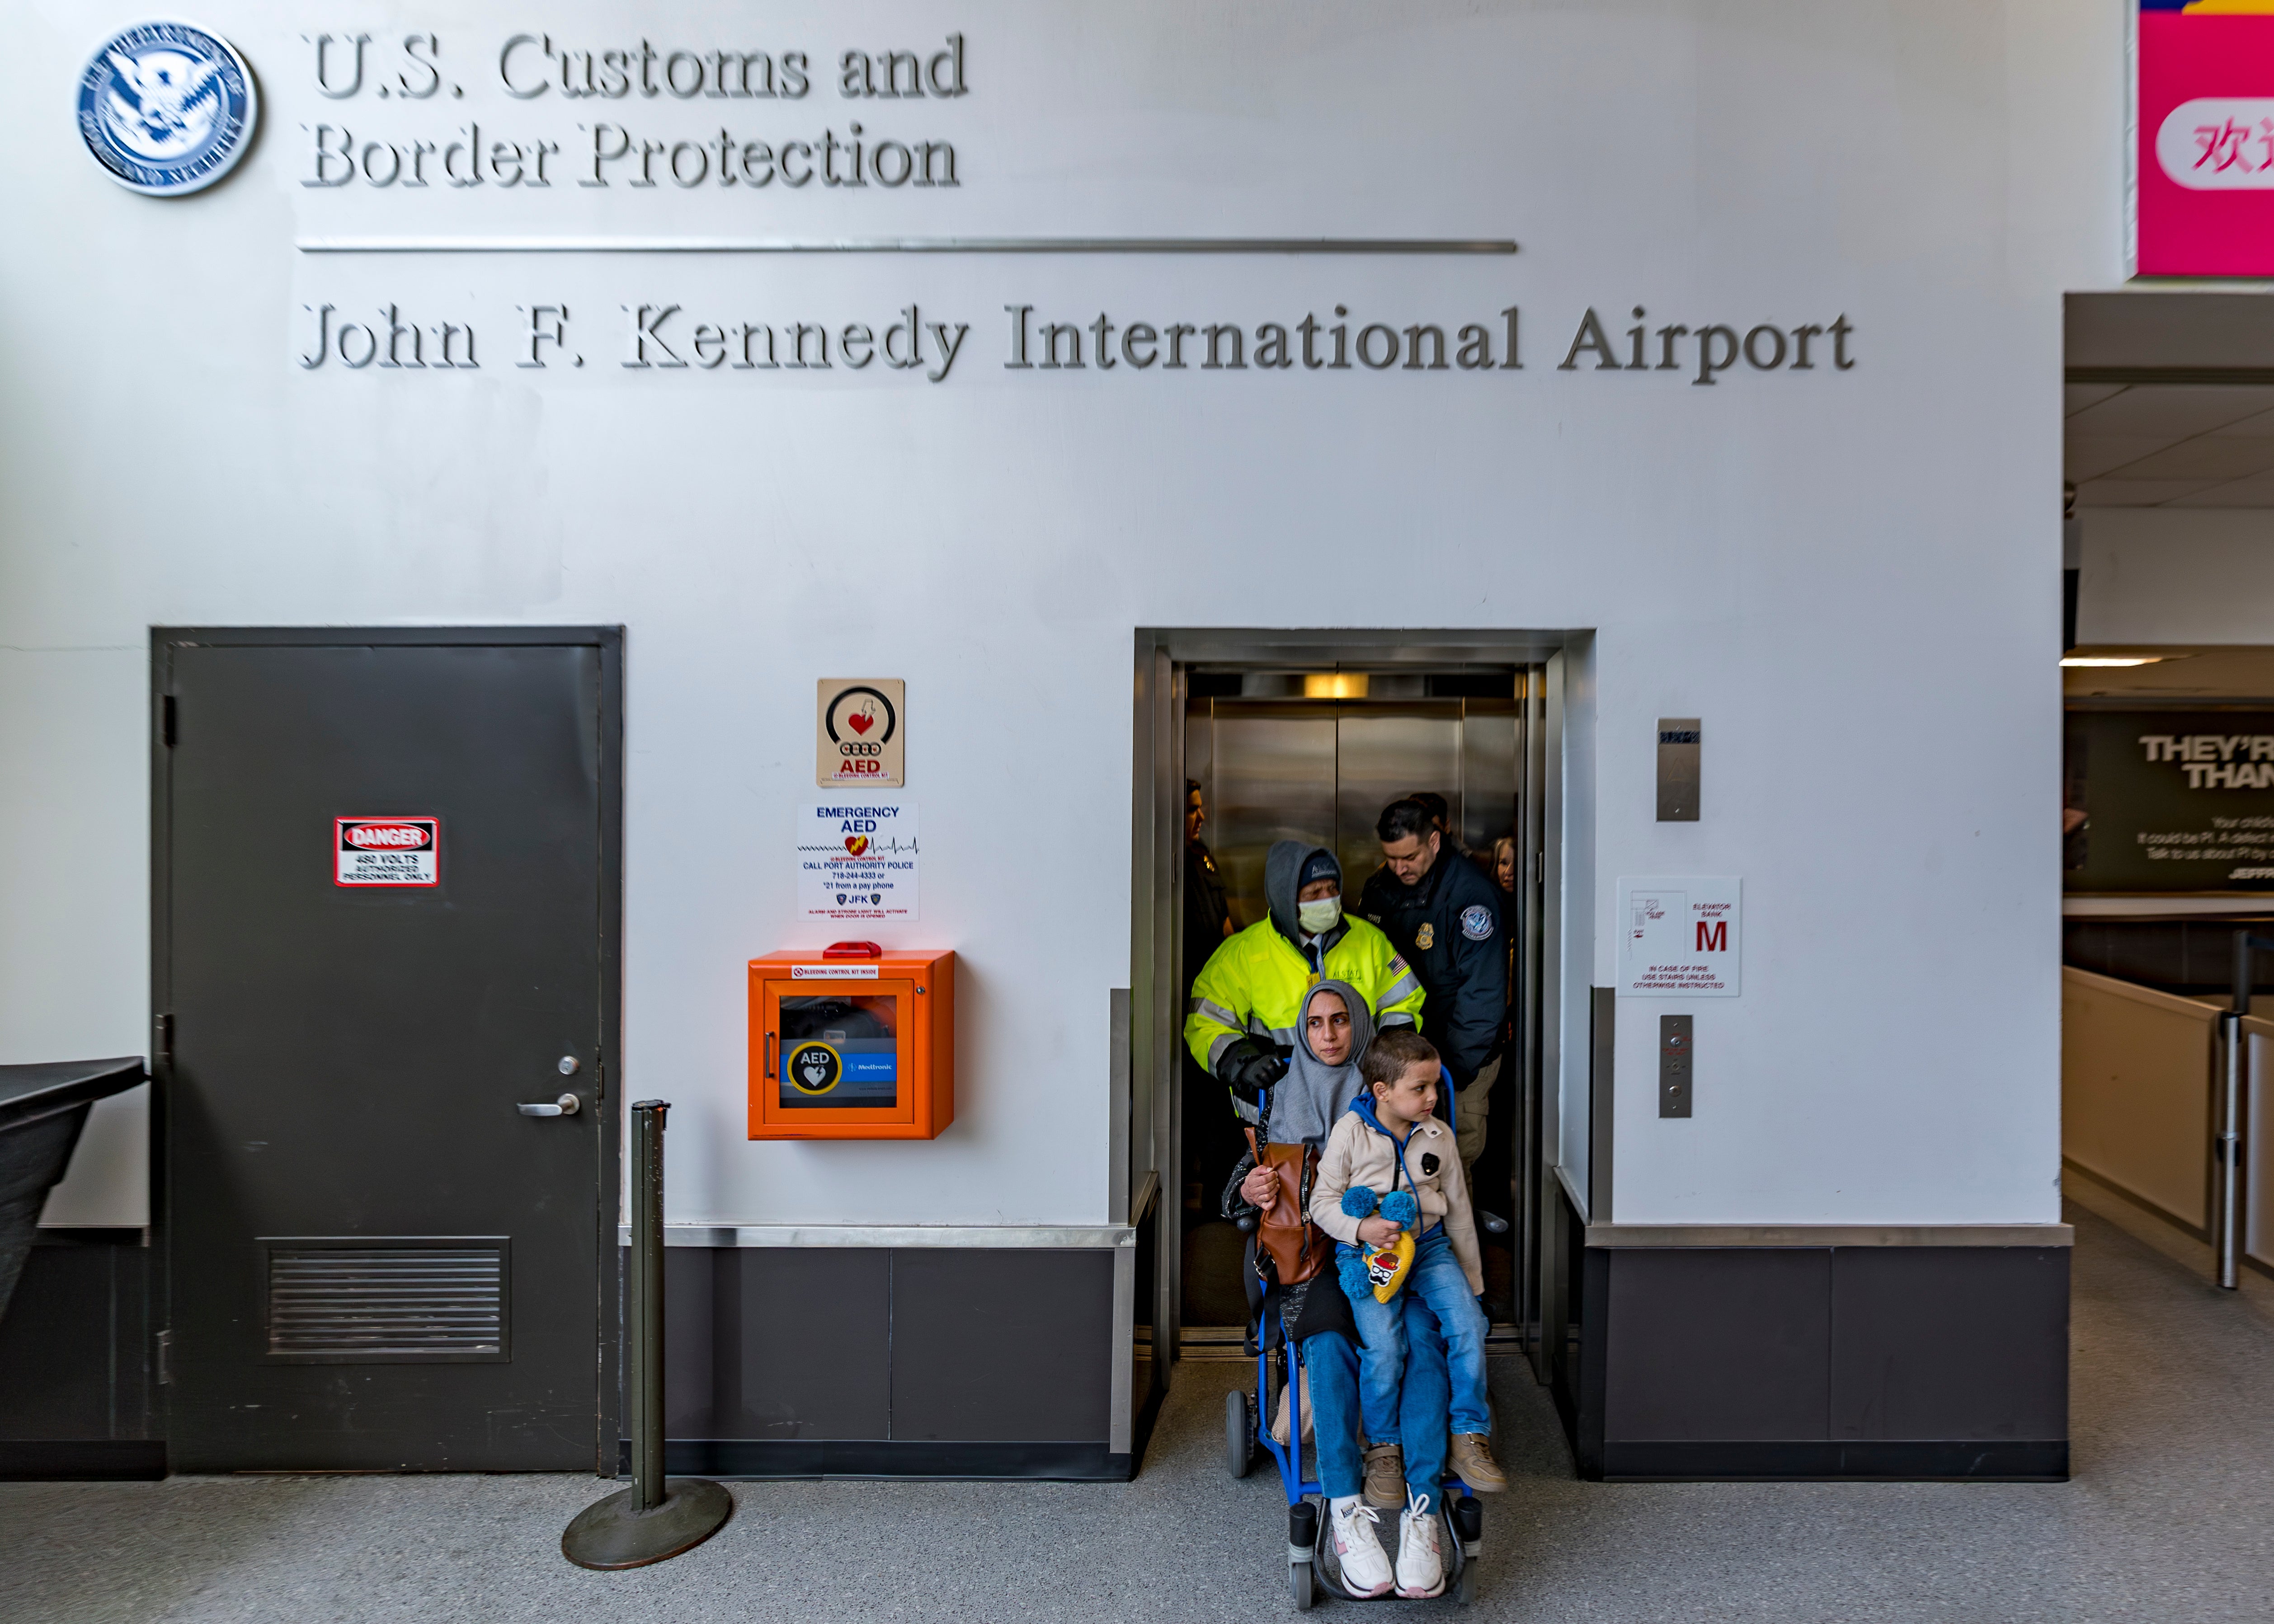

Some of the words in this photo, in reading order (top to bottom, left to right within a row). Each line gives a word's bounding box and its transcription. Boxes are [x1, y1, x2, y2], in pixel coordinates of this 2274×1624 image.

[301, 32, 464, 99] U.S.
[498, 32, 810, 99] Customs
[837, 31, 969, 99] and
[2192, 115, 2274, 175] 欢
[301, 121, 559, 188] Border
[576, 121, 963, 188] Protection
[298, 303, 481, 371] John
[515, 303, 585, 370] F.
[619, 303, 970, 383] Kennedy
[1002, 304, 1524, 372] International
[1556, 305, 1856, 386] Airport
[840, 759, 881, 773] AED
[816, 807, 899, 818] EMERGENCY
[841, 820, 877, 832] AED
[352, 828, 423, 846] DANGER
[380, 854, 419, 864] VOLTS
[873, 882, 894, 891] phone
[849, 895, 868, 904] JFK
[1695, 920, 1728, 952] M
[800, 1052, 830, 1065] AED
